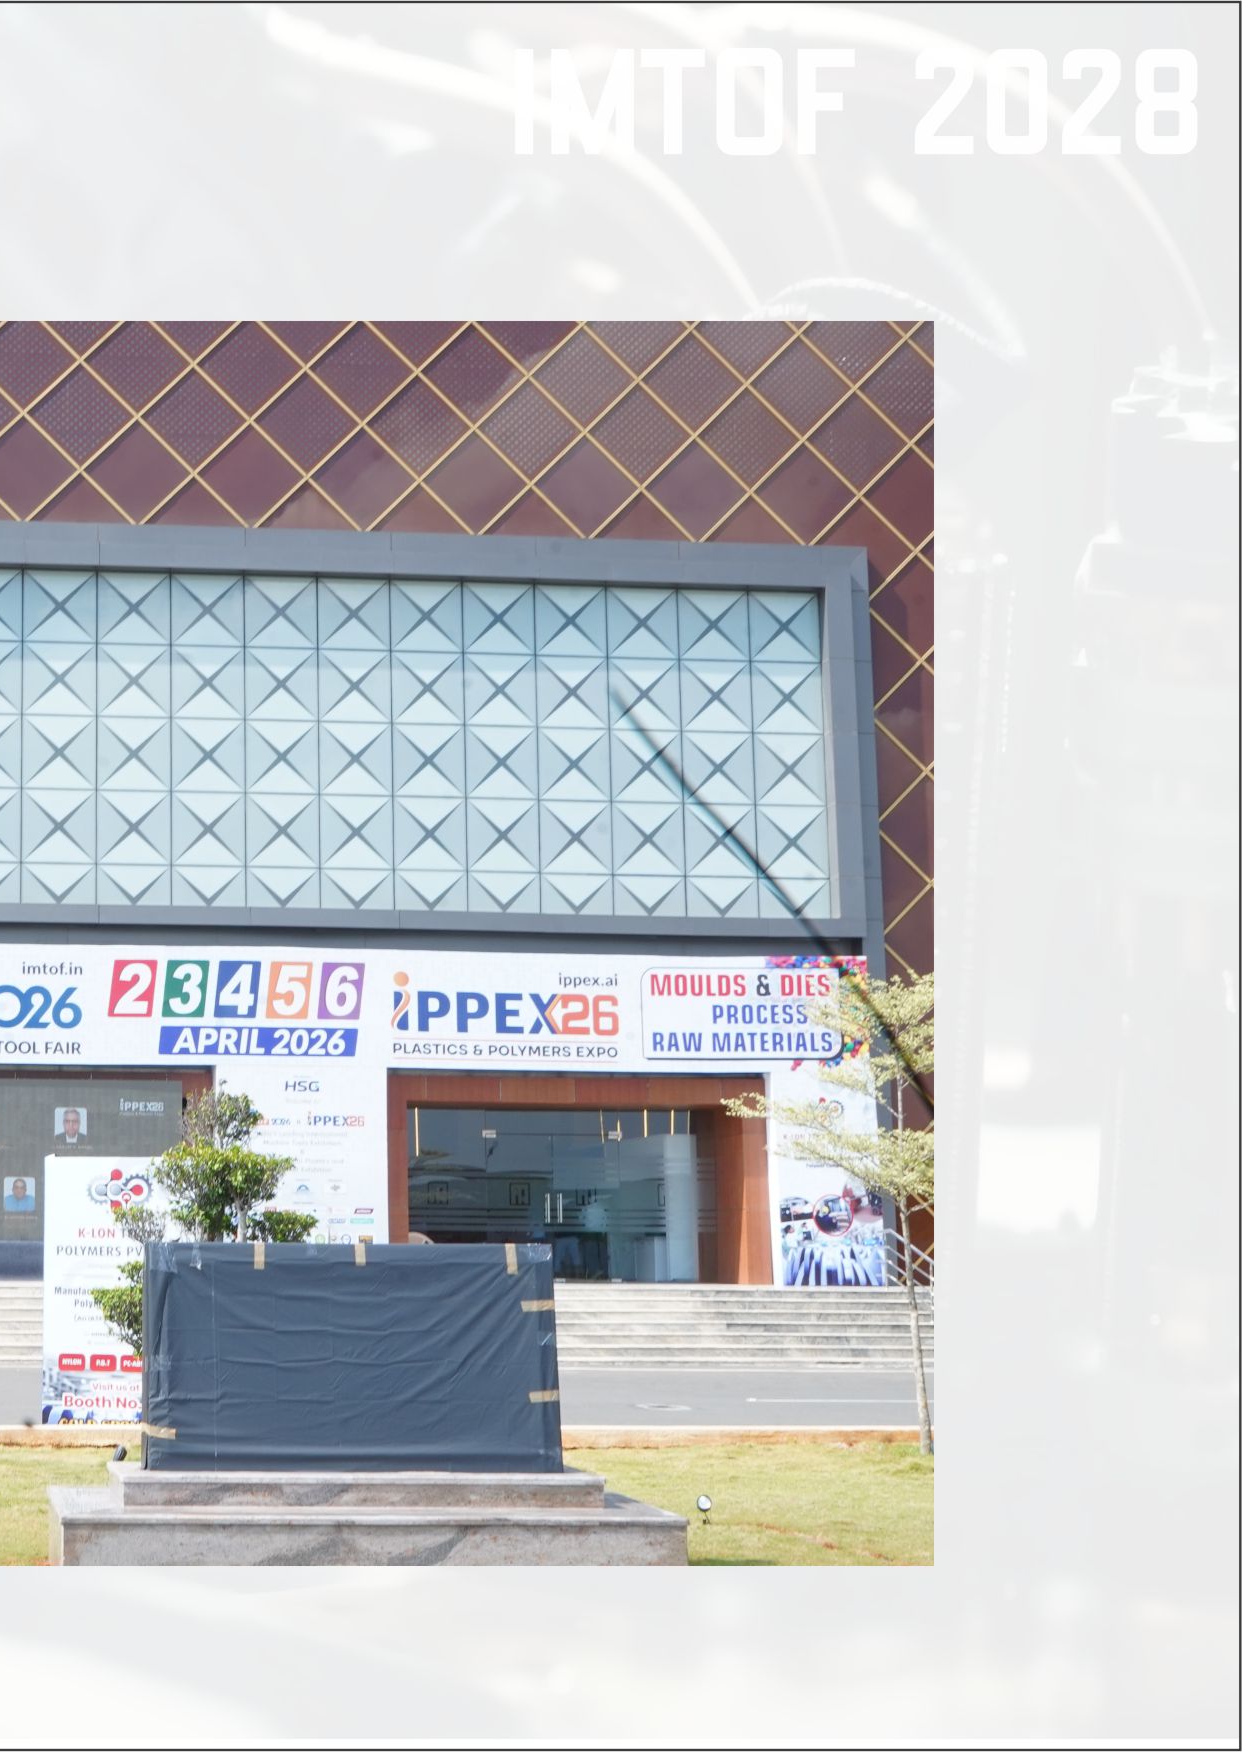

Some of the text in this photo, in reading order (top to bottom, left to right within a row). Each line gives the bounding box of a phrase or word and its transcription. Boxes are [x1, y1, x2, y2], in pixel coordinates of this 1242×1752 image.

[21, 961, 83, 976] imtof.in
[558, 973, 619, 988] ippex.ai
[650, 974, 831, 997] MOULDS & DIES
[113, 962, 360, 1017] 2 3 4 5 6
[712, 1004, 809, 1025] PROCESS
[44, 1041, 82, 1055] FAIR
[171, 1027, 346, 1056] APRIL 2026
[652, 1032, 833, 1052] RAW MATERIALS
[393, 1042, 619, 1059] PLASTICS & POLYMERS EXPO
[284, 1080, 320, 1092] HSG
[56, 1245, 143, 1257] POLYMERS PV
[92, 1383, 114, 1391] Visit
[130, 1384, 140, 1392] at
[63, 1395, 112, 1408] Booth
